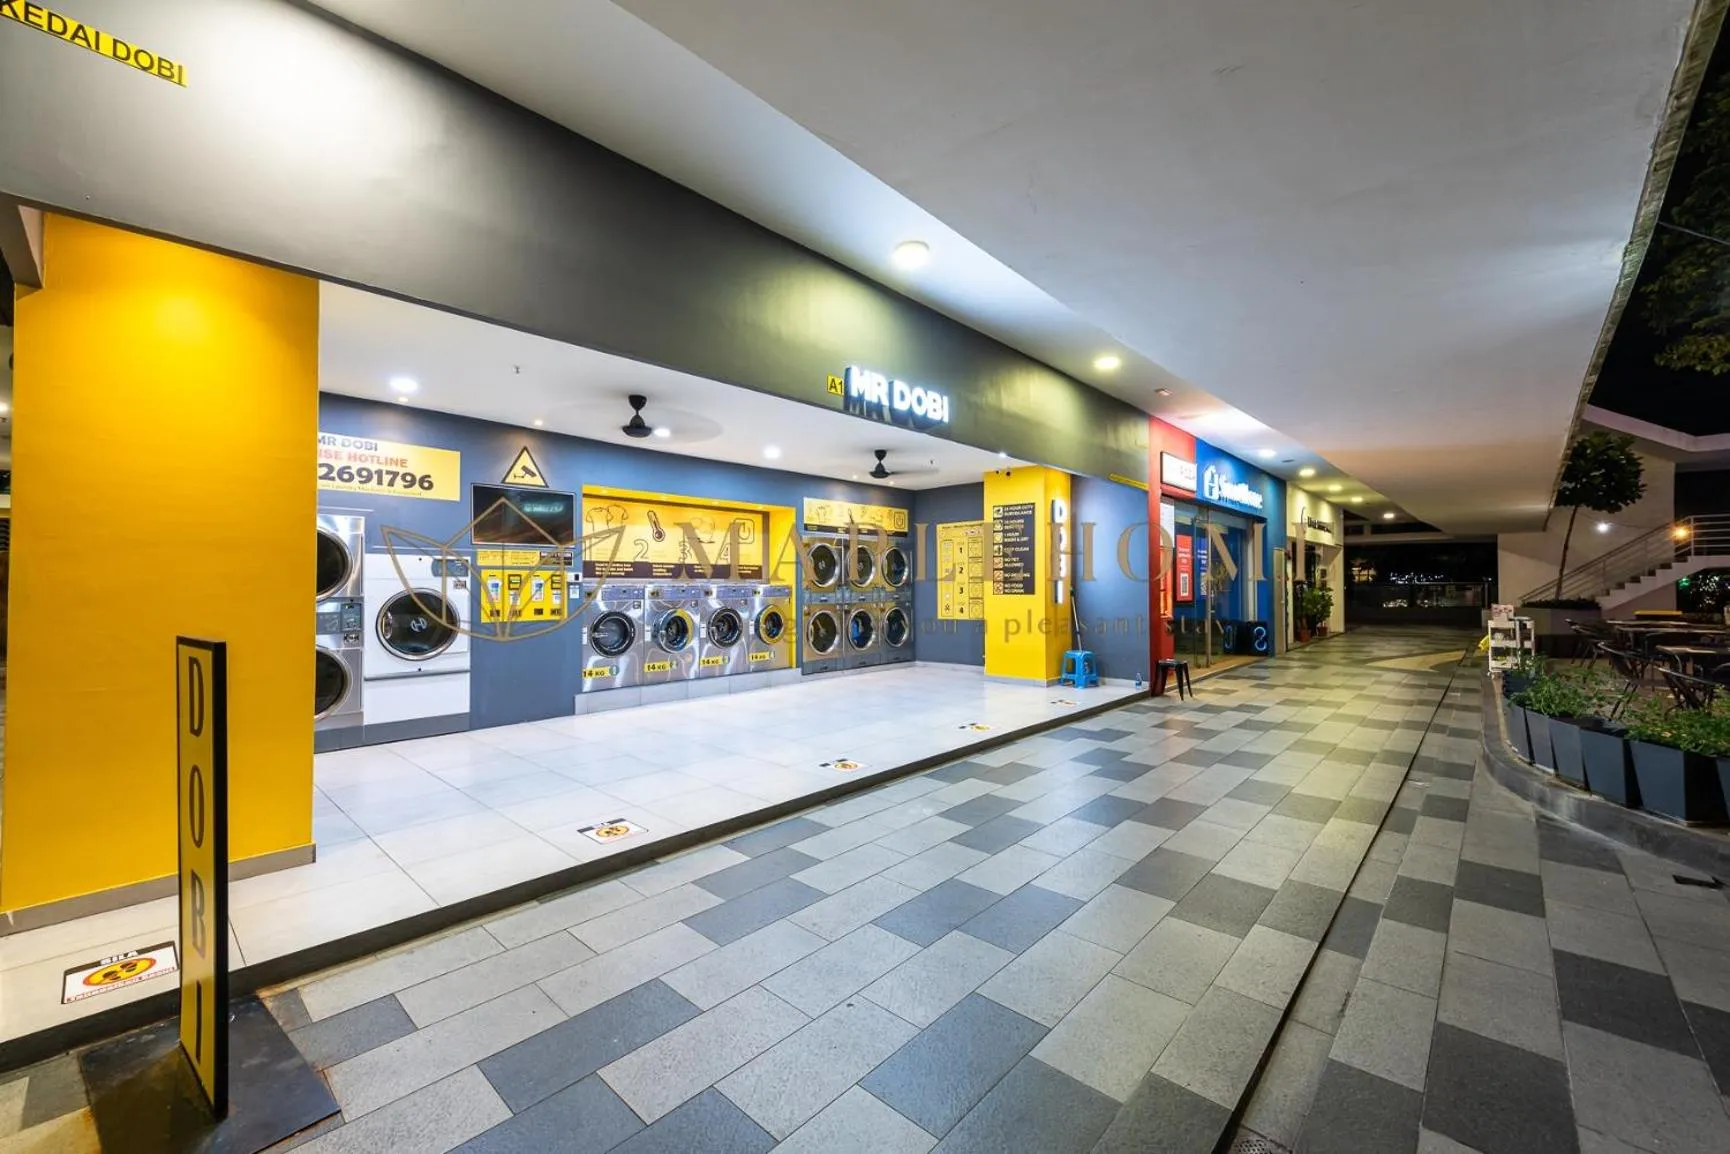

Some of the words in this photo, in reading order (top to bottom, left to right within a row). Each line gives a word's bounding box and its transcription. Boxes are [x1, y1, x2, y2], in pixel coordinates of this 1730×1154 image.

[0, 0, 100, 50] KEDAI
[112, 38, 183, 83] DOBI
[829, 378, 843, 393] A1
[849, 366, 889, 407] MR
[893, 380, 949, 423] DOBI
[340, 438, 378, 452] DOBI
[347, 451, 408, 469] HOTLINE
[318, 462, 434, 491] 2691796
[1052, 499, 1068, 604] DOBI
[188, 656, 206, 1064] DOBI
